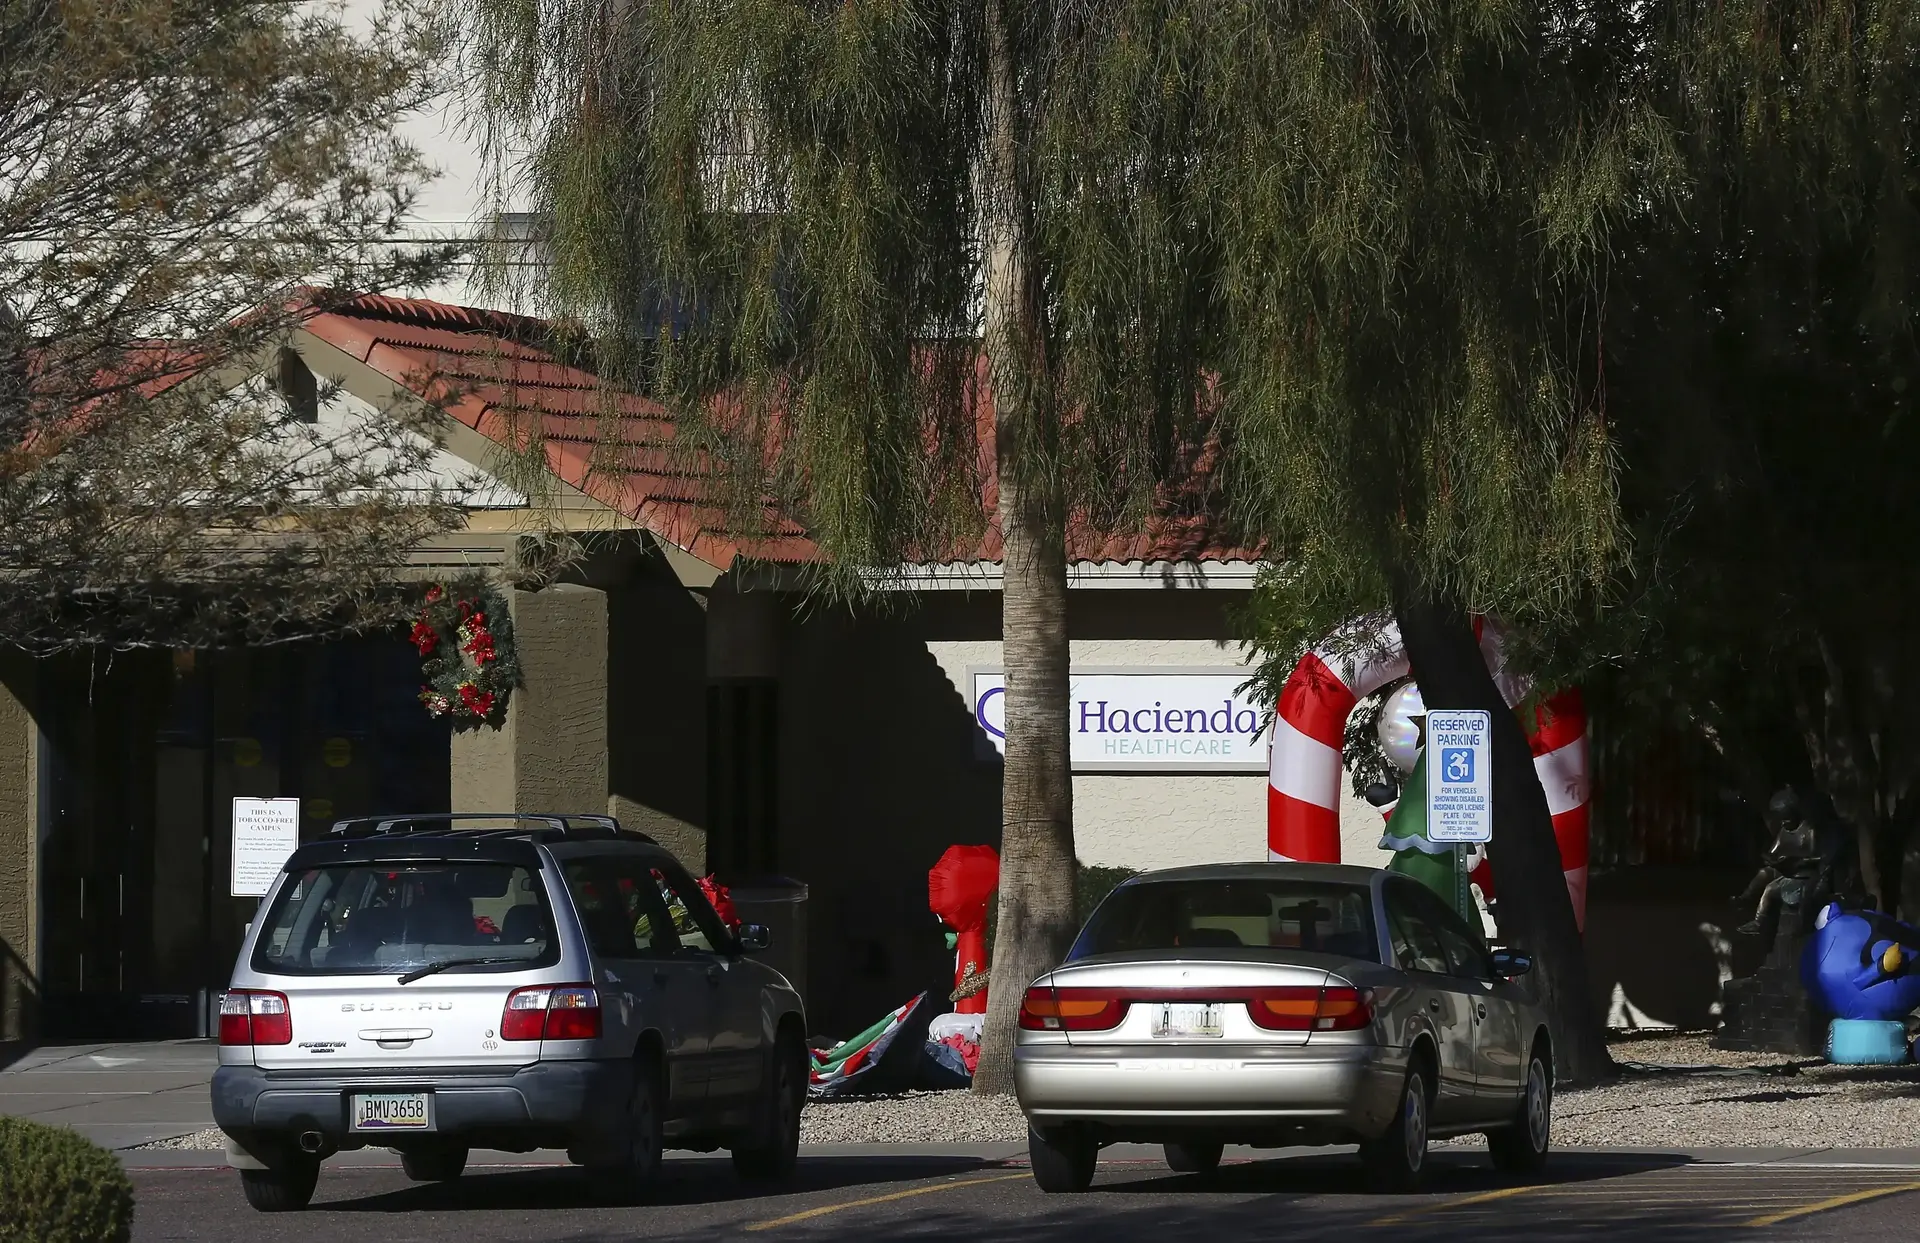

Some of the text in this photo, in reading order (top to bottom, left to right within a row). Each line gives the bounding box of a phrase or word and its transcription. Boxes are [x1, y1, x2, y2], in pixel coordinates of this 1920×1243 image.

[1078, 699, 1257, 735] Hacienda
[1432, 720, 1484, 730] RESERVED
[1104, 738, 1232, 755] HEALTHCARE
[1437, 734, 1480, 746] PARKING
[1460, 795, 1484, 803] DISABLED
[1162, 1010, 1220, 1028] AL3011
[365, 1100, 424, 1119] BMV3658
